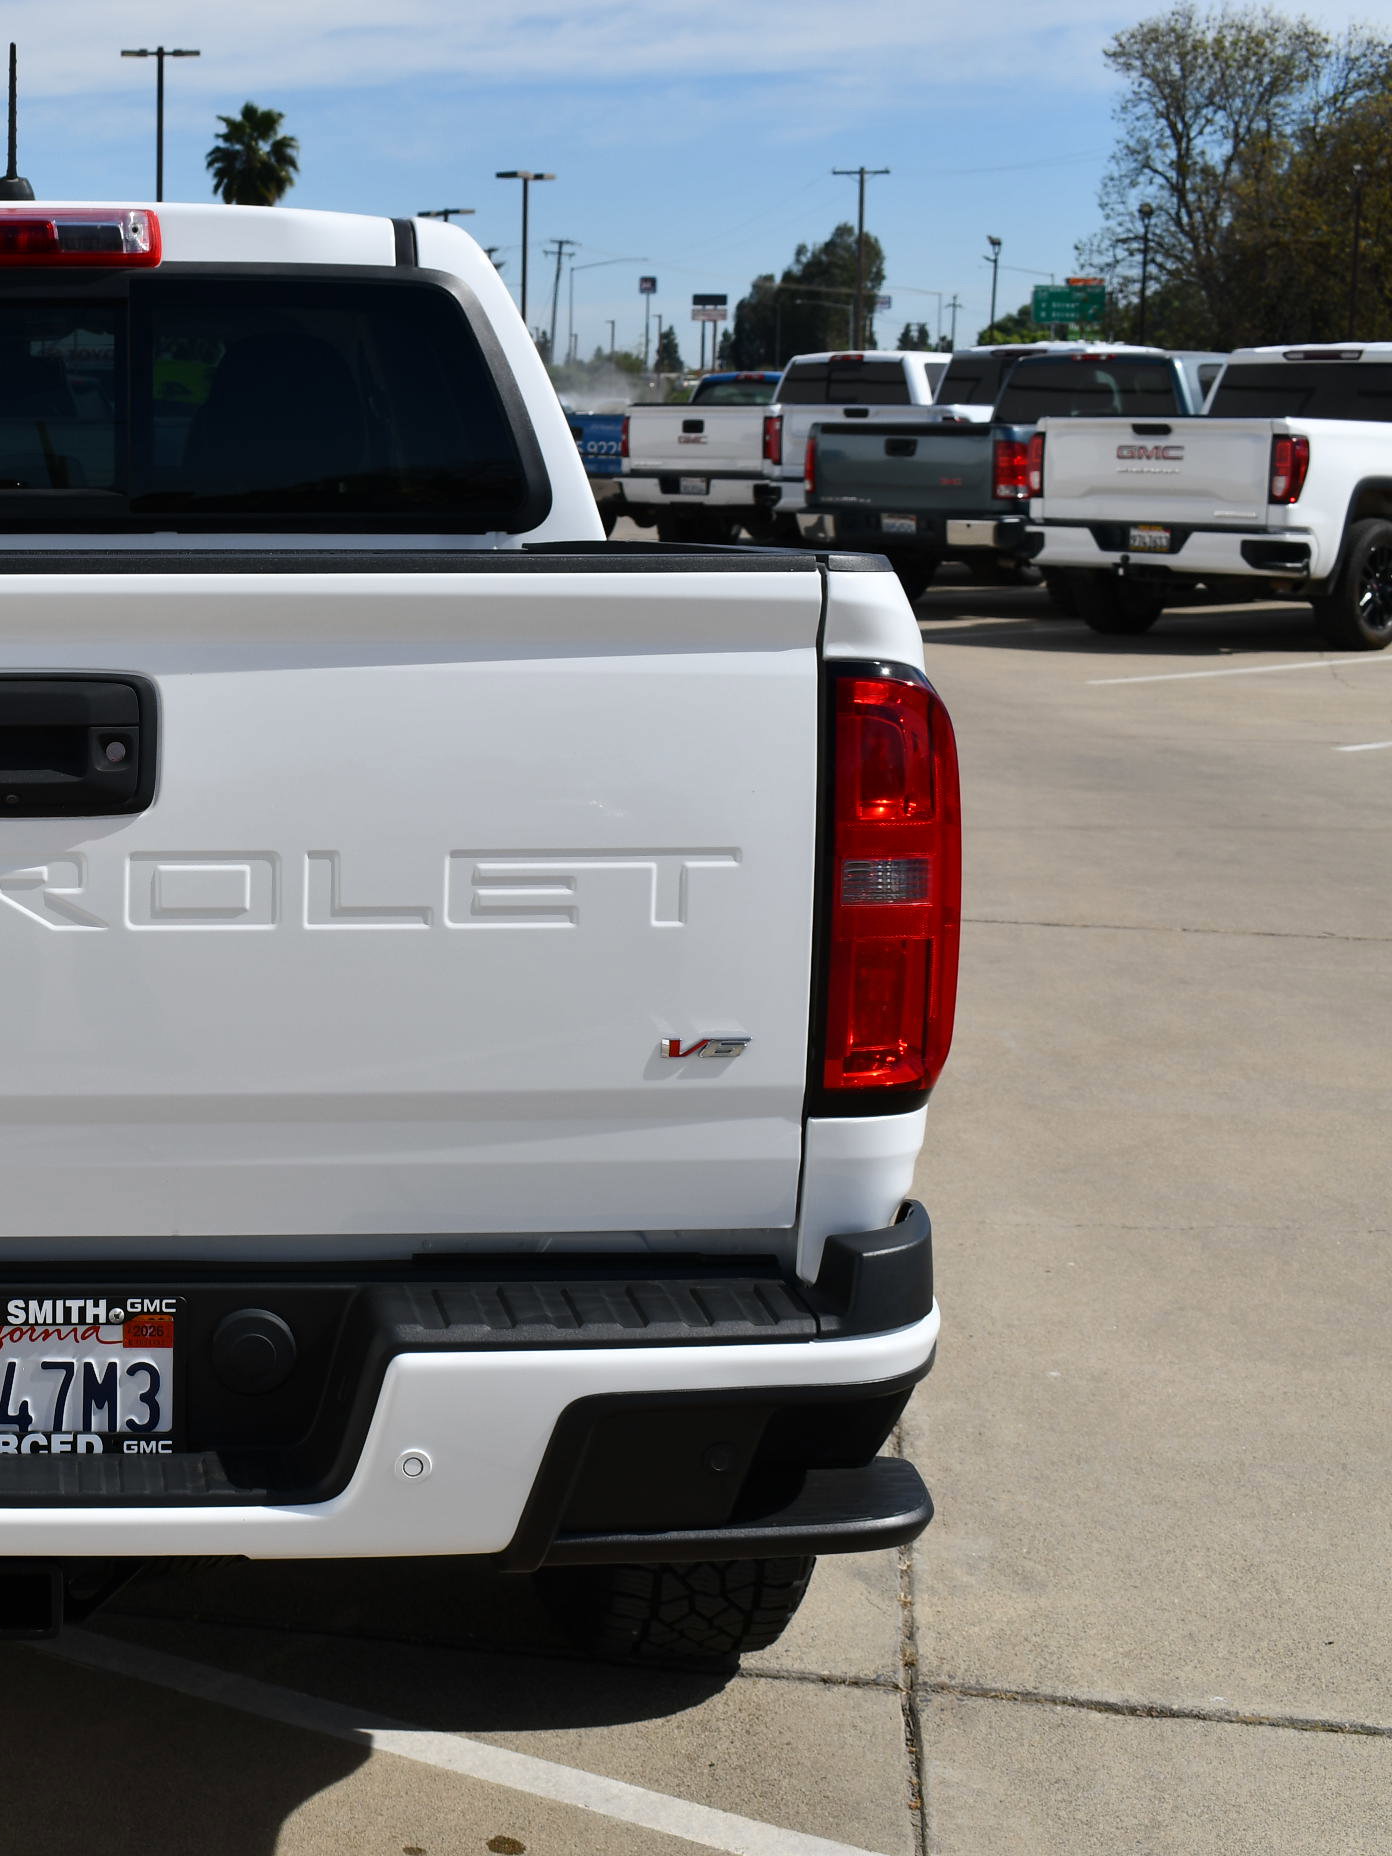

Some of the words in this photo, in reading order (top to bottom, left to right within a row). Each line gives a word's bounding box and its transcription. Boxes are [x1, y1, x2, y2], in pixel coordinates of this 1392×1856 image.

[1116, 445, 1185, 460] GMC
[660, 1037, 752, 1058] V6
[7, 1299, 107, 1324] SMITH
[126, 1298, 177, 1313] GMC
[133, 1325, 164, 1337] 2026
[123, 1440, 173, 1454] GMC
